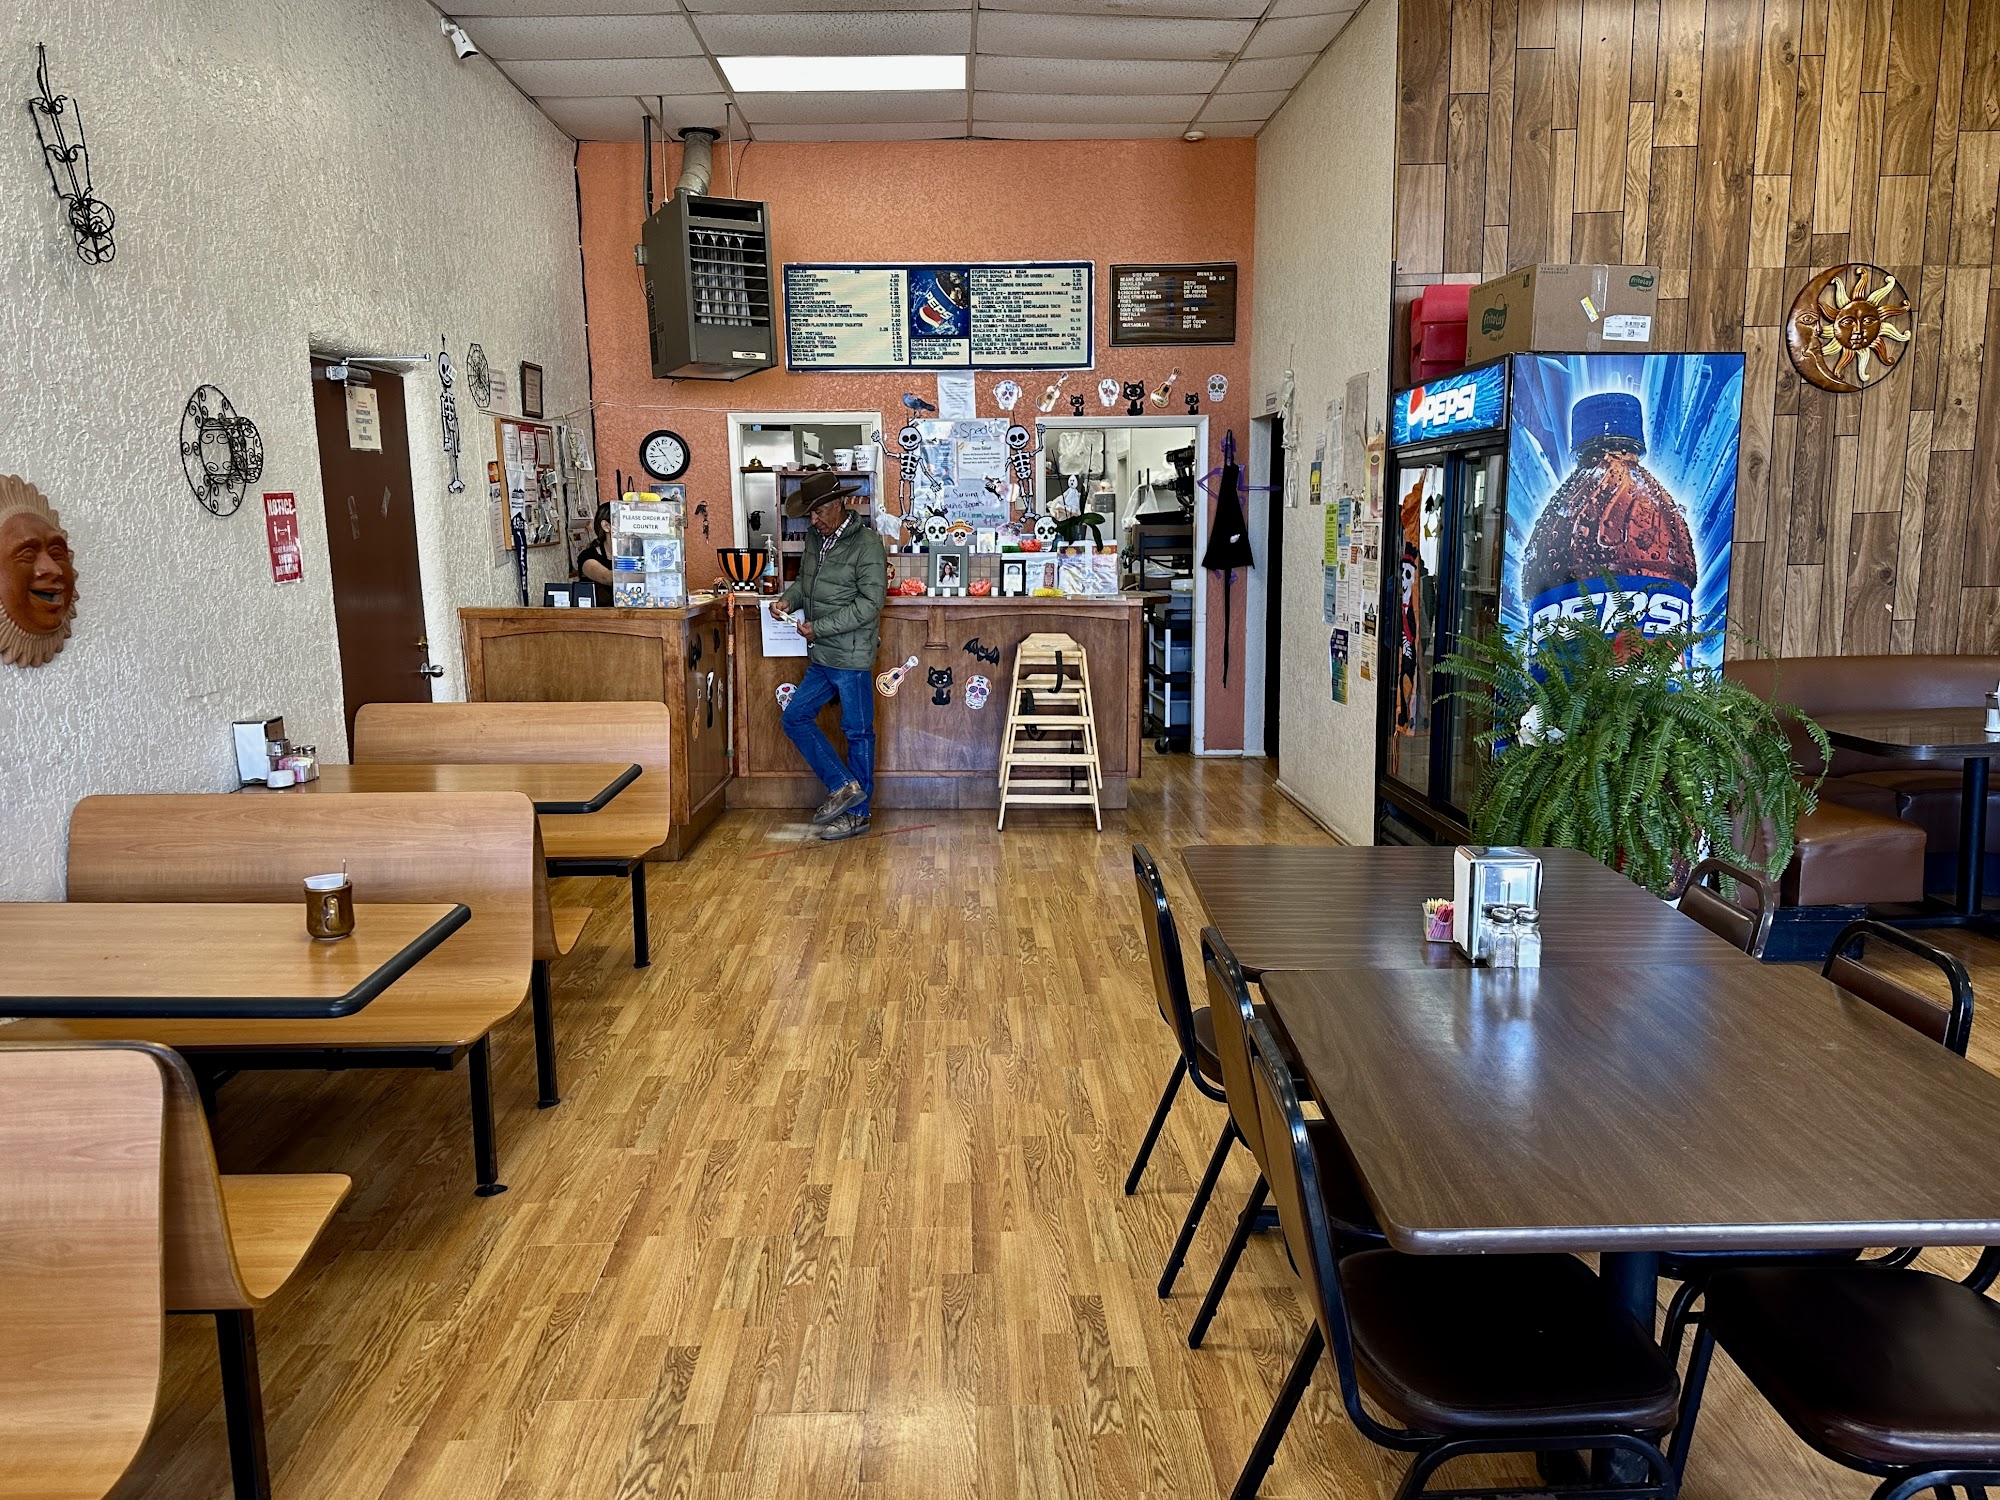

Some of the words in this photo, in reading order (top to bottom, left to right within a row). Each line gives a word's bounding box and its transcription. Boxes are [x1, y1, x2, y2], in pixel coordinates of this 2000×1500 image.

[925, 290, 954, 320] PEPS
[1422, 383, 1477, 428] PEPSI
[267, 498, 296, 516] NOTICE
